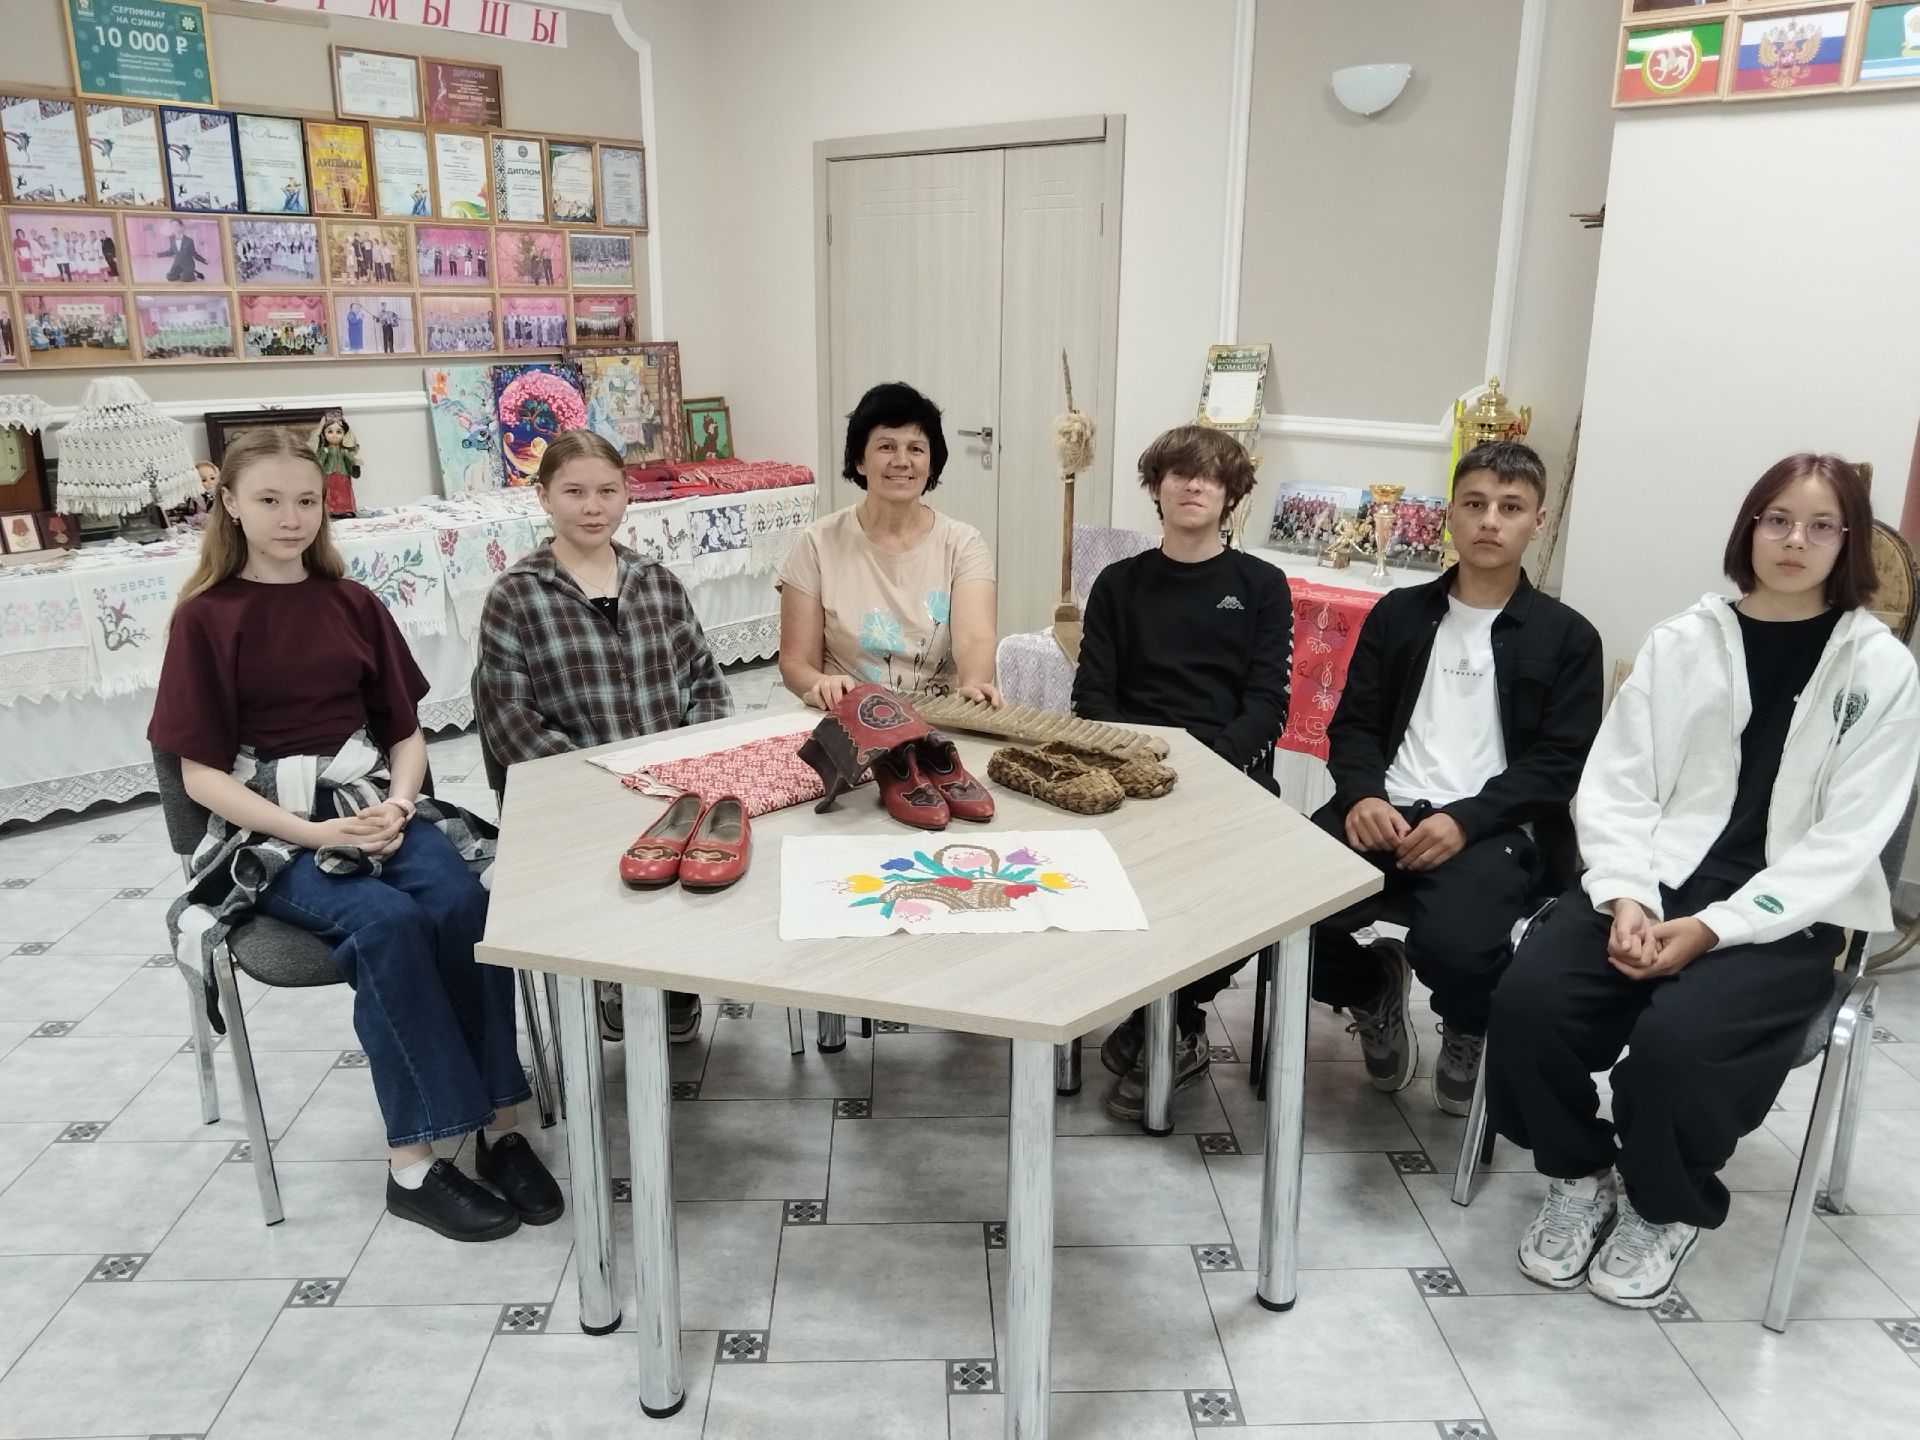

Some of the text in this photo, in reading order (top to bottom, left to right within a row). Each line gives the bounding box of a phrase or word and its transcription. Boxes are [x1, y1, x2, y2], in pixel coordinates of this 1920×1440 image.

[112, 5, 166, 19] СЕРТИФИКАТ
[116, 16, 165, 29] НА СУММУ
[95, 25, 123, 48] 10
[128, 30, 170, 54] 000
[316, 157, 363, 170] ДИПЛОМ
[507, 167, 541, 176] ДИПЛОМ
